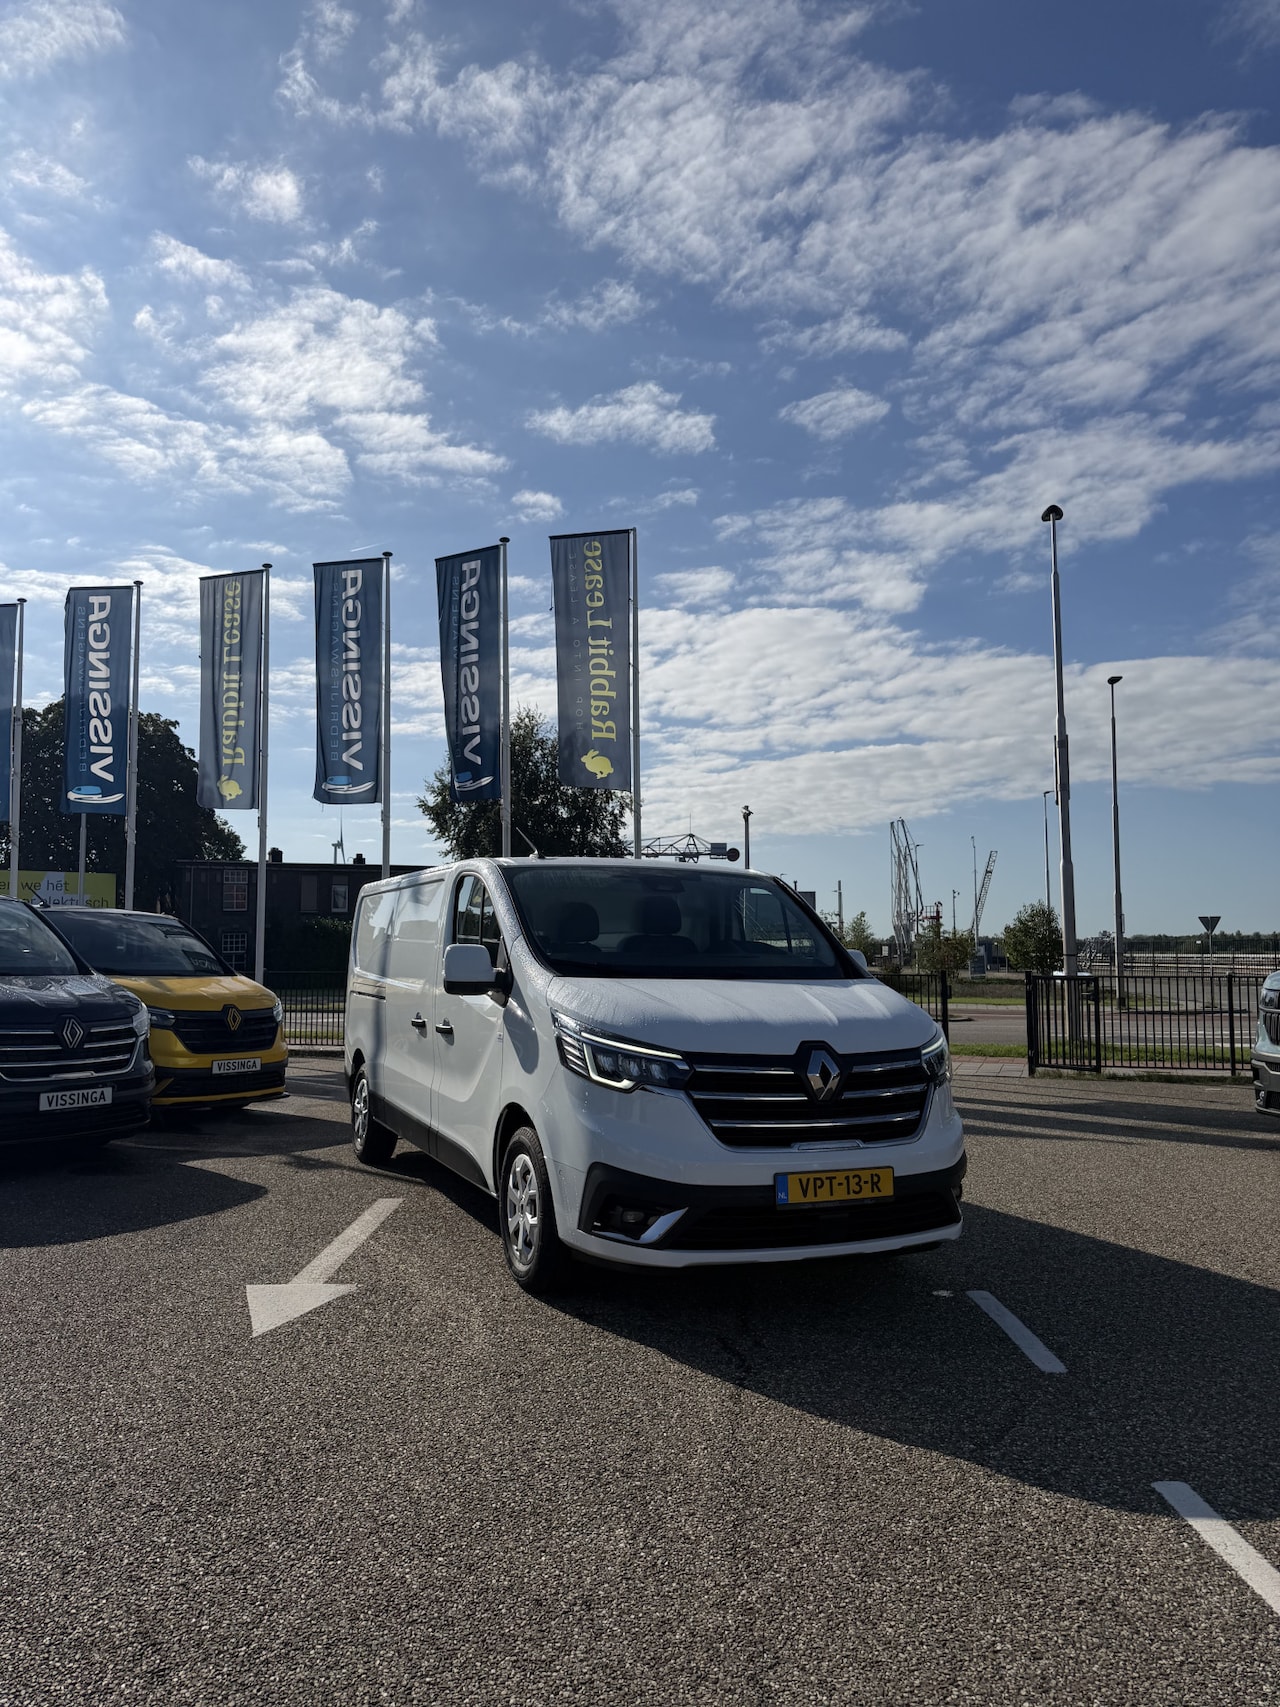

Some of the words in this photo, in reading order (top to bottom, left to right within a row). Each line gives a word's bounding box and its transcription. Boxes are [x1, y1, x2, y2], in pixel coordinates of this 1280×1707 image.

[20, 881, 41, 891] we
[217, 1060, 258, 1072] VISSINGA
[46, 1089, 107, 1108] VISSINGA
[798, 1173, 882, 1198] VPT-13-R
